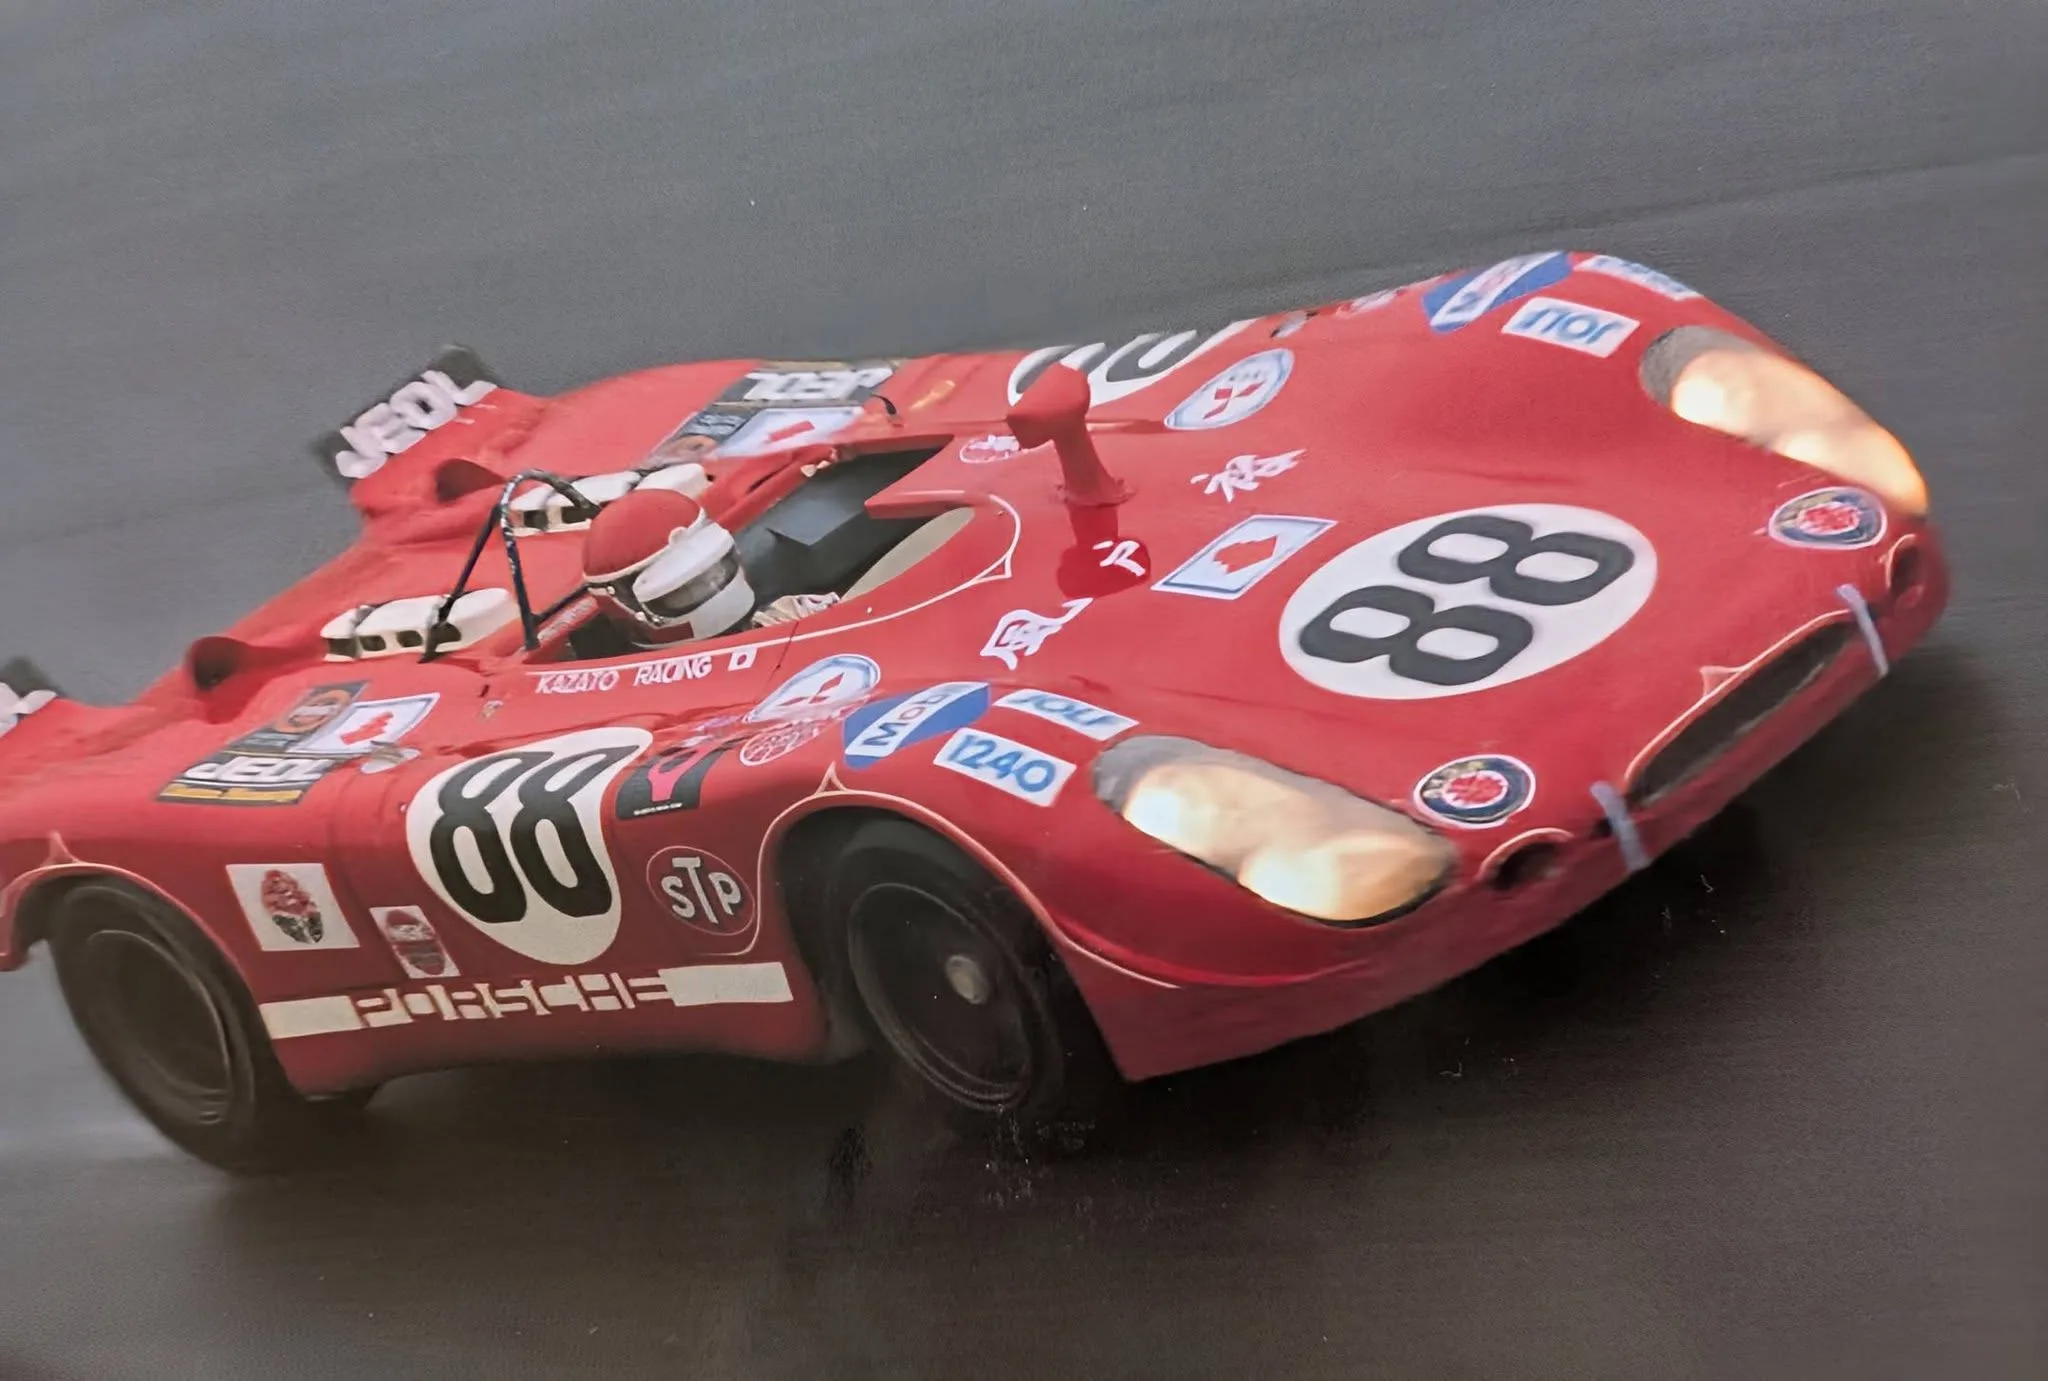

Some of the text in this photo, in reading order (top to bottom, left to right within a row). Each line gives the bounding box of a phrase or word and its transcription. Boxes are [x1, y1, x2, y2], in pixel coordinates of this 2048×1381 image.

[1300, 514, 1635, 686] 88
[535, 654, 712, 694] KAZATO RACING
[948, 733, 1057, 793] 1240
[429, 745, 640, 924] 88
[660, 856, 742, 924] STP
[350, 970, 672, 1028] PORSCHE
